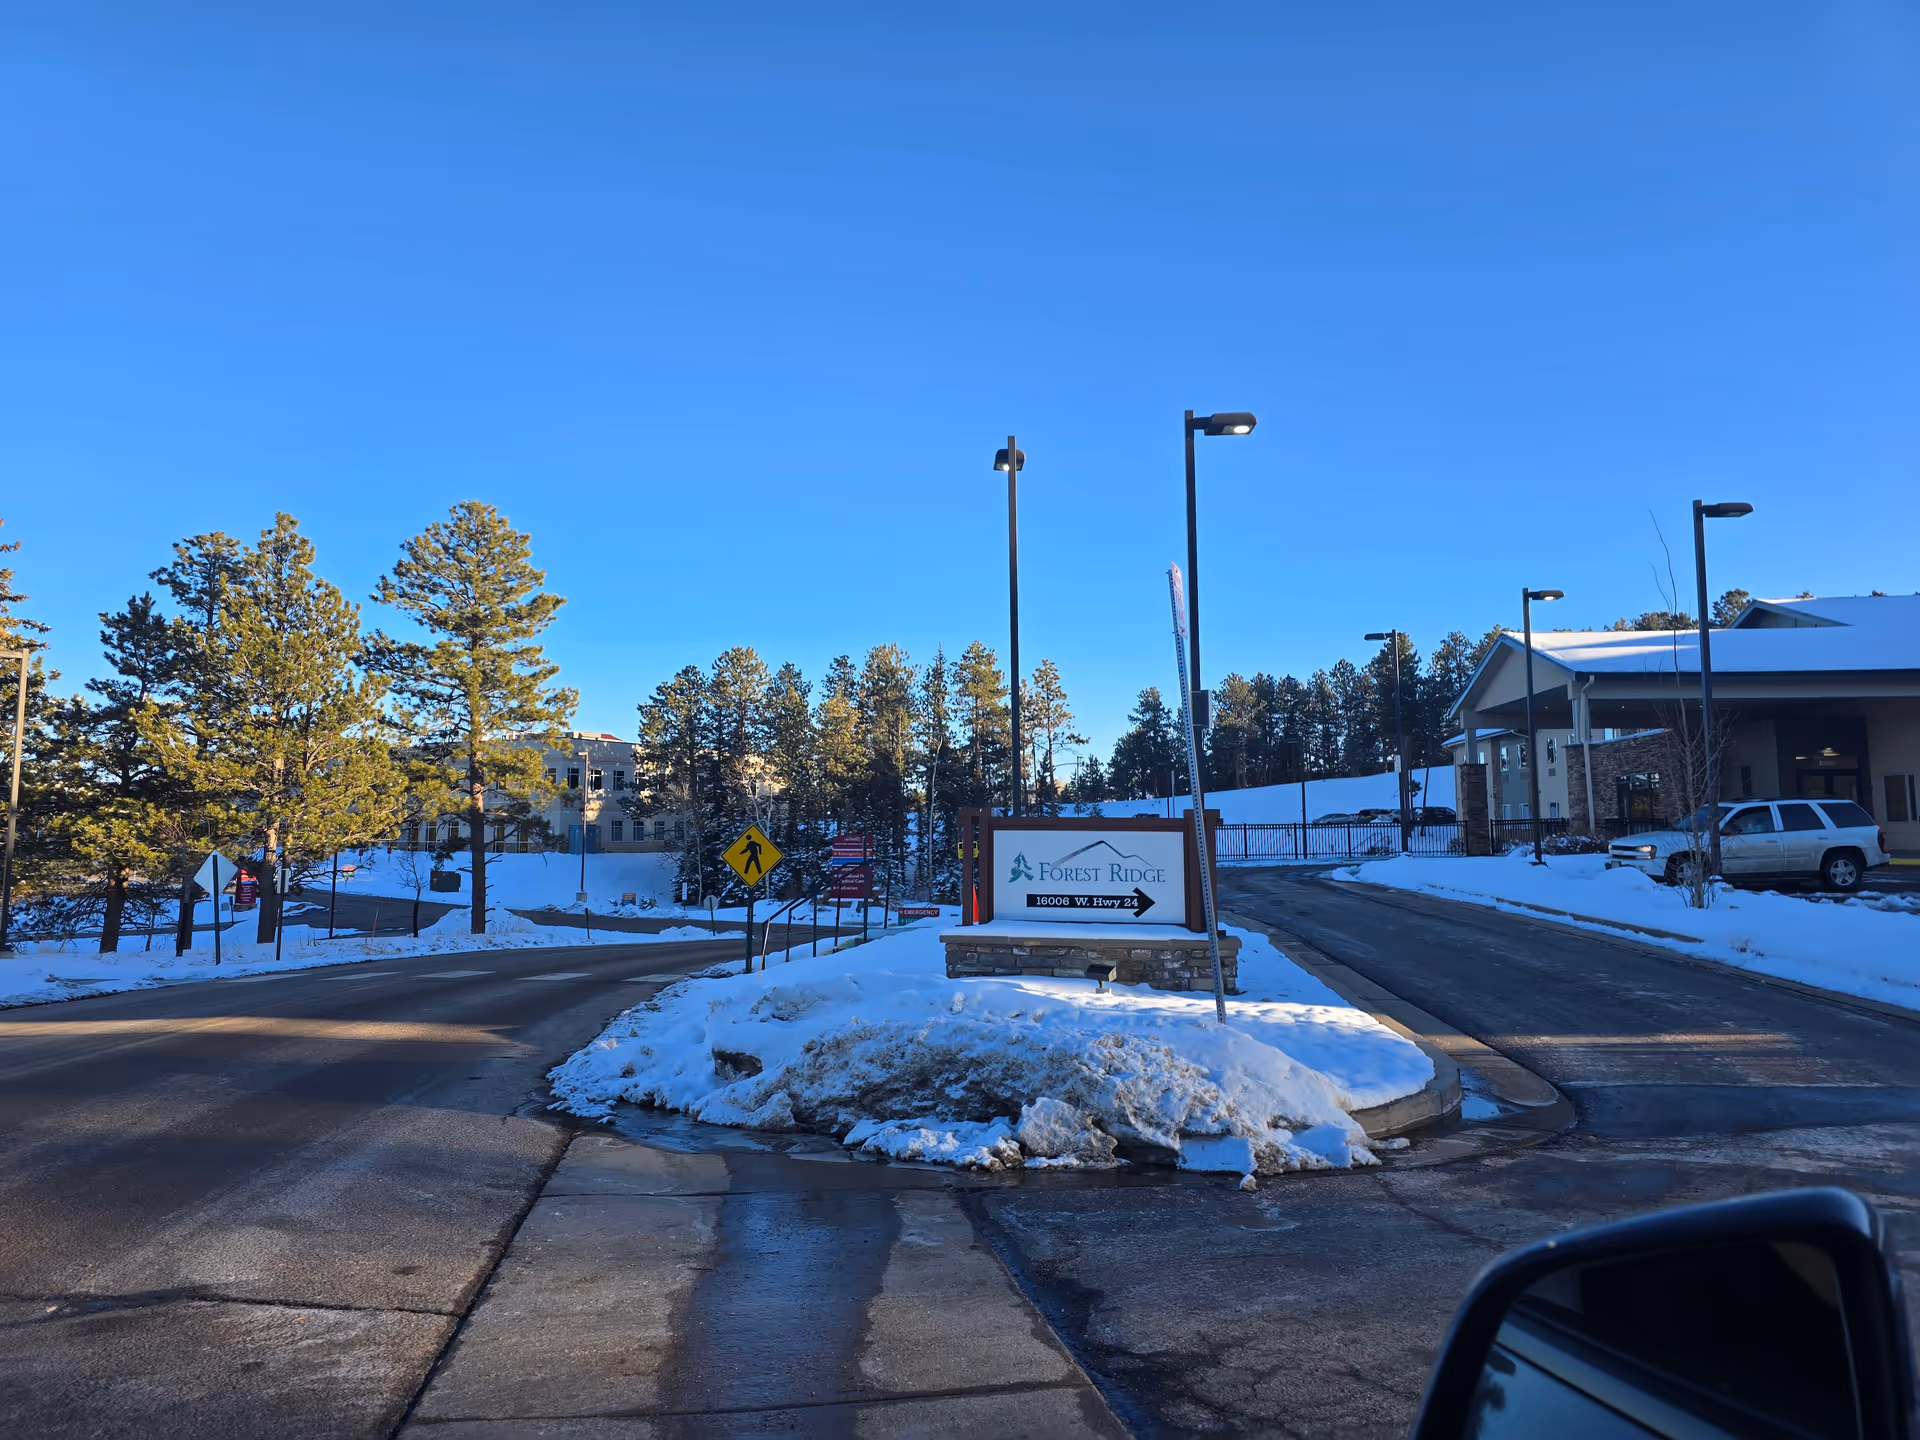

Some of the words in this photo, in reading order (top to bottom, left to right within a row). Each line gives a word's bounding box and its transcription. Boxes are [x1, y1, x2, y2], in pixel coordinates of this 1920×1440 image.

[1038, 862, 1102, 882] FOREST
[1108, 863, 1166, 883] RIDGE
[1036, 896, 1070, 906] 16006
[1074, 897, 1090, 906] W.
[1092, 897, 1121, 909] Hwy
[1124, 898, 1139, 907] 24
